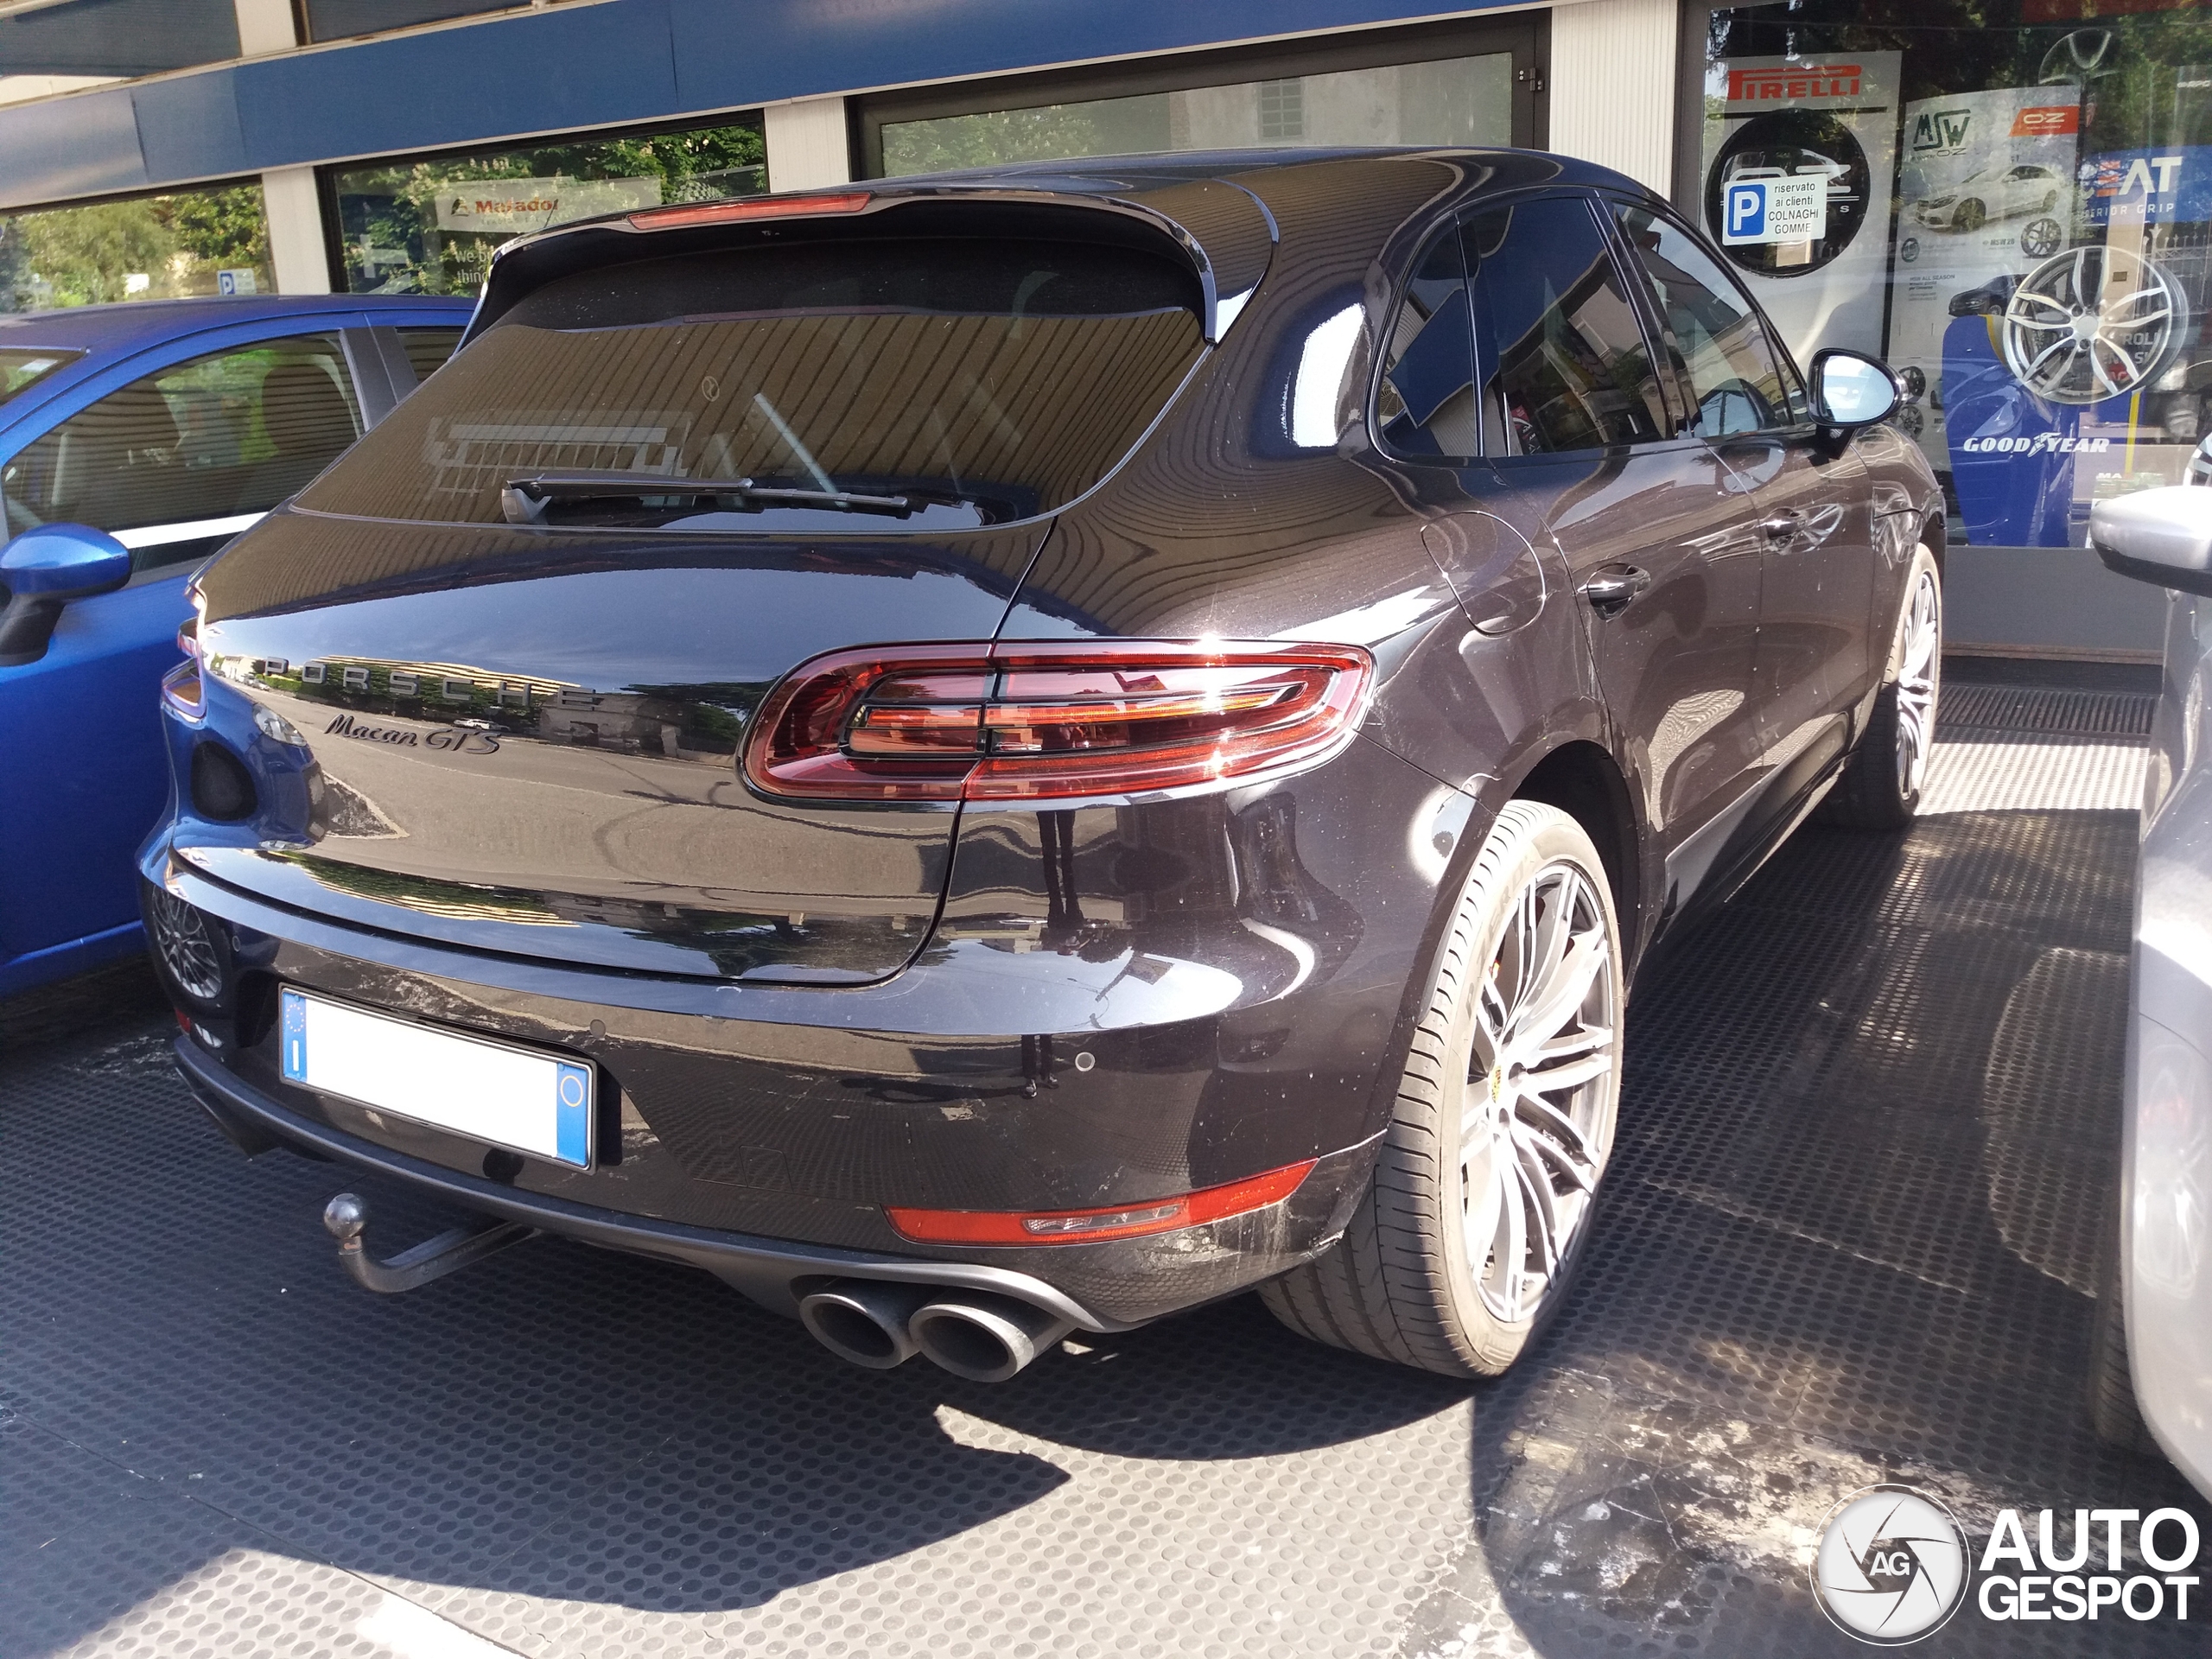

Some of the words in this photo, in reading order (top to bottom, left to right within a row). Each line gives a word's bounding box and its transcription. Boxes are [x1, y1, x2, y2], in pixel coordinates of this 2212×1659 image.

[1727, 65, 1862, 101] PIRELLI
[1912, 109, 1971, 152] MSW
[1774, 181, 1815, 194] riservato
[475, 196, 559, 214] Matador
[1776, 199, 1783, 207] ai
[1785, 195, 1814, 207] clienti
[2137, 203, 2175, 214] GRIP
[1732, 191, 1760, 232] P
[1768, 208, 1819, 221] COLNAGHI
[1774, 223, 1812, 235] GOMME
[454, 250, 474, 263] We
[264, 656, 598, 712] PORSCHE
[324, 714, 418, 747] Macan
[423, 728, 502, 755] GTS
